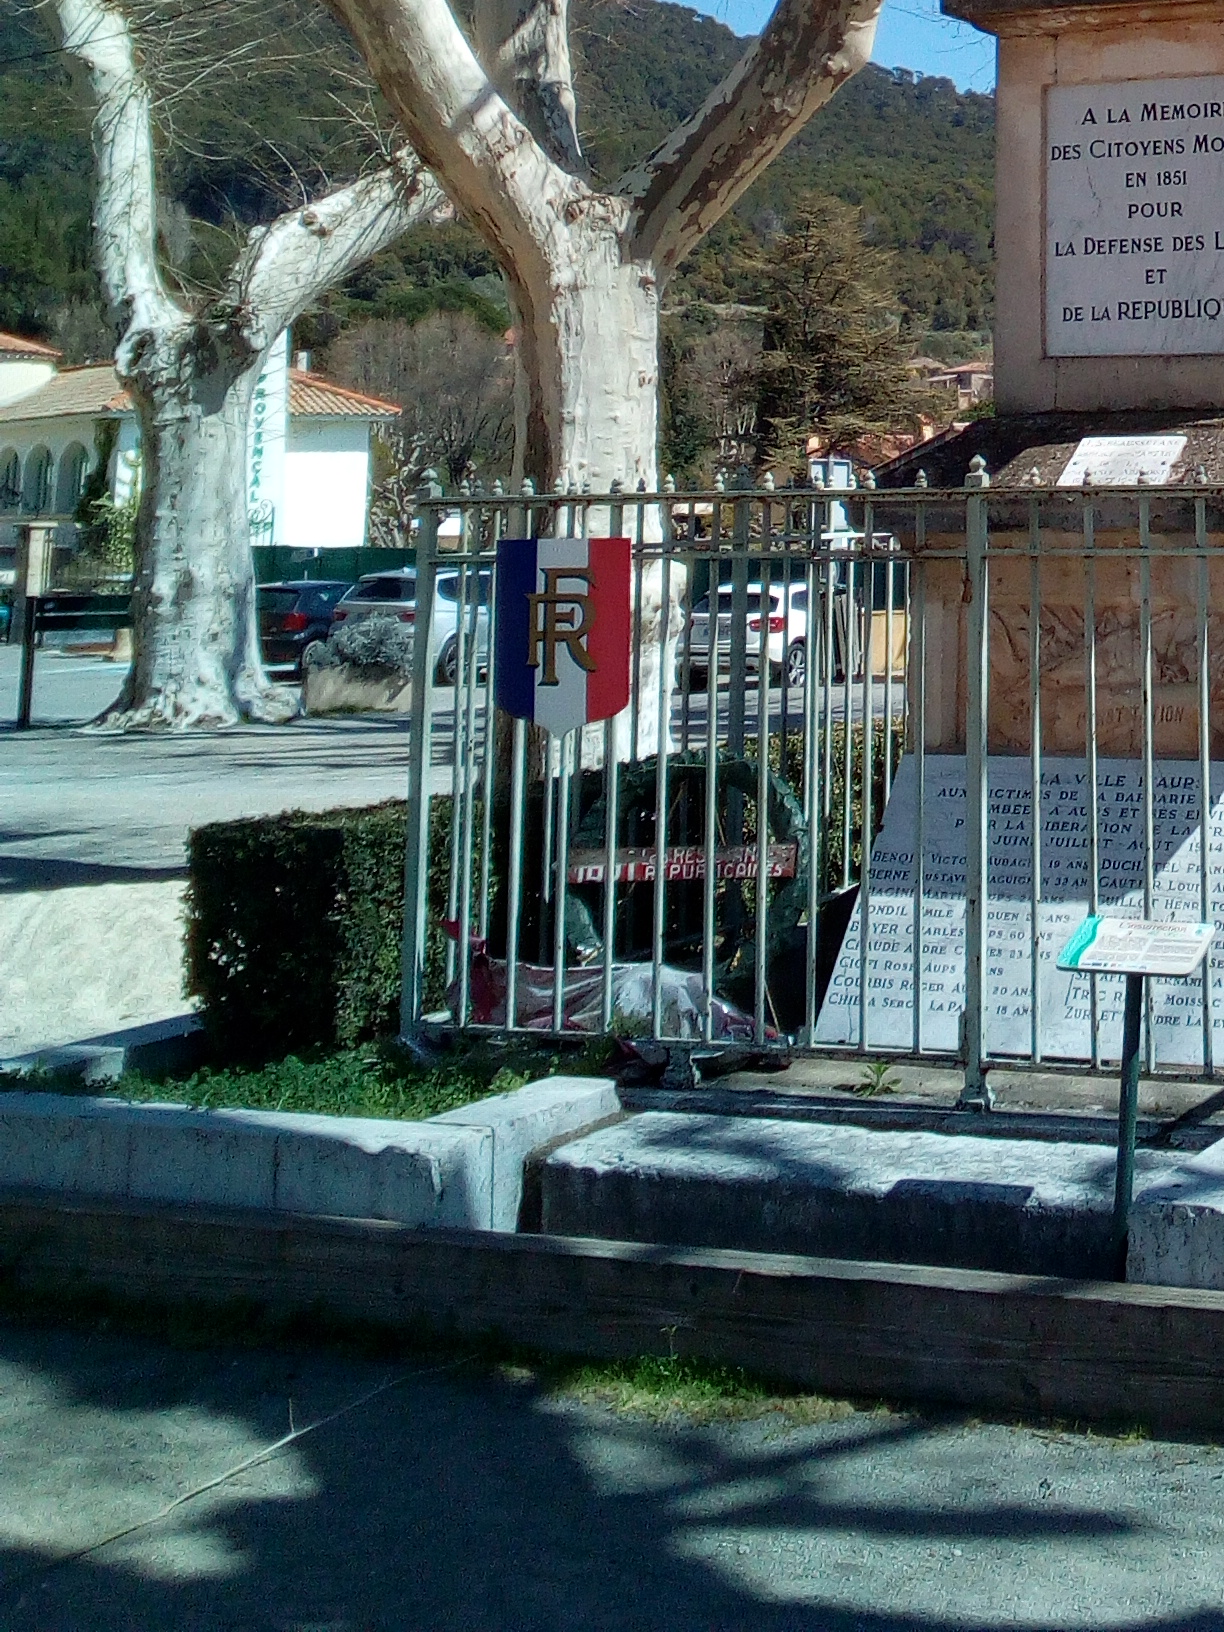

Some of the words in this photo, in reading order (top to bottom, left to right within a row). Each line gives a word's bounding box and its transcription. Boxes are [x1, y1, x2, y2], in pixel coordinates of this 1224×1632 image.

[1081, 108, 1097, 125] A
[1107, 108, 1131, 124] LA
[1051, 145, 1081, 161] DES
[1089, 139, 1185, 159] CITOYENS
[1125, 172, 1147, 188] EN
[1156, 171, 1188, 186] 1851
[1128, 202, 1183, 218] POUR
[1055, 241, 1076, 257] LA
[1083, 237, 1164, 255] DEFENSE
[1172, 235, 1205, 252] DES
[1145, 269, 1168, 285] ET
[1062, 306, 1084, 322] DE
[1091, 306, 1111, 321] LA
[984, 788, 1052, 801] ICTIMS
[1058, 792, 1079, 801] DE
[1049, 806, 1060, 816] A
[1068, 807, 1111, 817] AUS
[1119, 808, 1140, 818] ET
[954, 818, 998, 831] PR
[1005, 820, 1024, 831] LA
[1171, 825, 1191, 837] LA
[931, 854, 970, 866] VICTO
[849, 921, 899, 935] BYER
